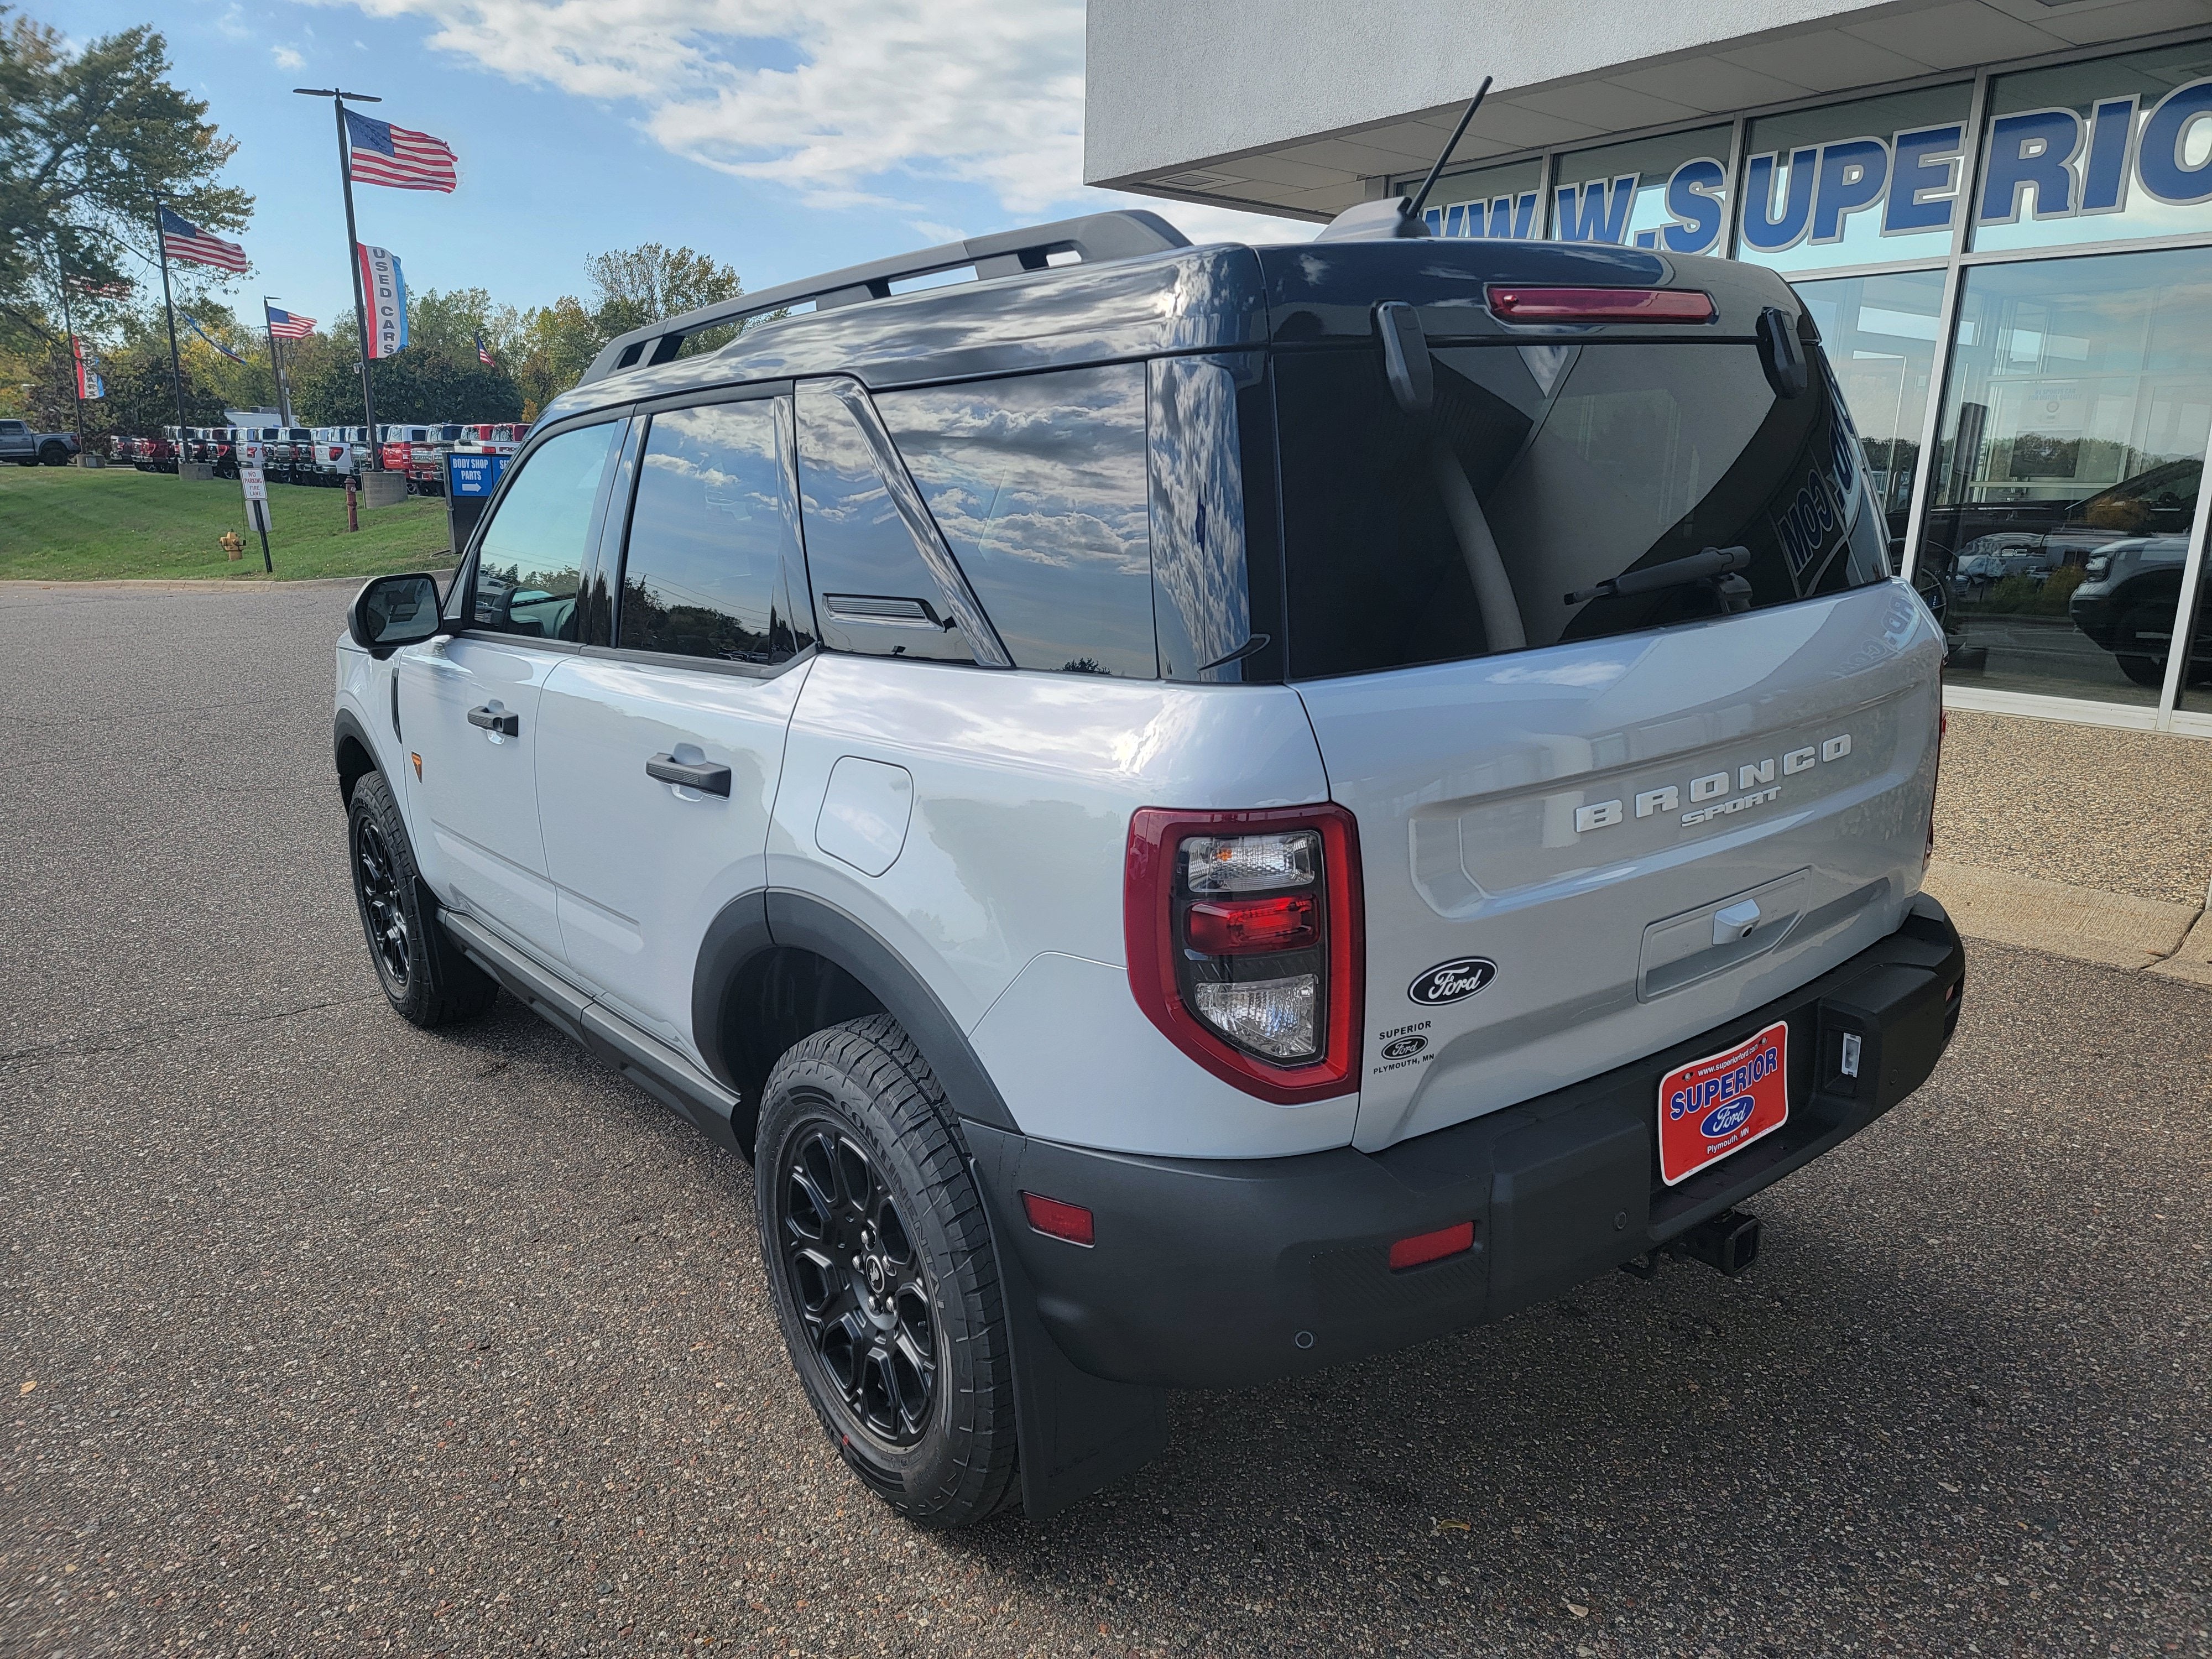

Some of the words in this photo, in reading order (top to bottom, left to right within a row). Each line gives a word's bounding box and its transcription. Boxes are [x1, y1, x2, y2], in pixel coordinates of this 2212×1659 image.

[373, 248, 392, 298] USED
[380, 306, 395, 354] CARS
[452, 458, 469, 469] BODY
[471, 459, 488, 469] SHOP
[461, 470, 482, 481] PARTS
[499, 460, 509, 469] SE
[1575, 733, 1851, 833] BRONCO
[1681, 786, 1782, 827] SPORT
[1428, 966, 1483, 1000] Ford
[1379, 1020, 1432, 1040] SUPERIOR
[1392, 1040, 1418, 1056] Ford
[1698, 1044, 1759, 1077] www.superiorford.com
[1373, 1058, 1420, 1074] PLYMOUTH,
[1422, 1053, 1434, 1062] MN
[1670, 1046, 1777, 1121] SUPERIOR
[1713, 1102, 1747, 1132] Ford
[1707, 1134, 1739, 1155] Plymouth,
[1740, 1126, 1749, 1138] MN
